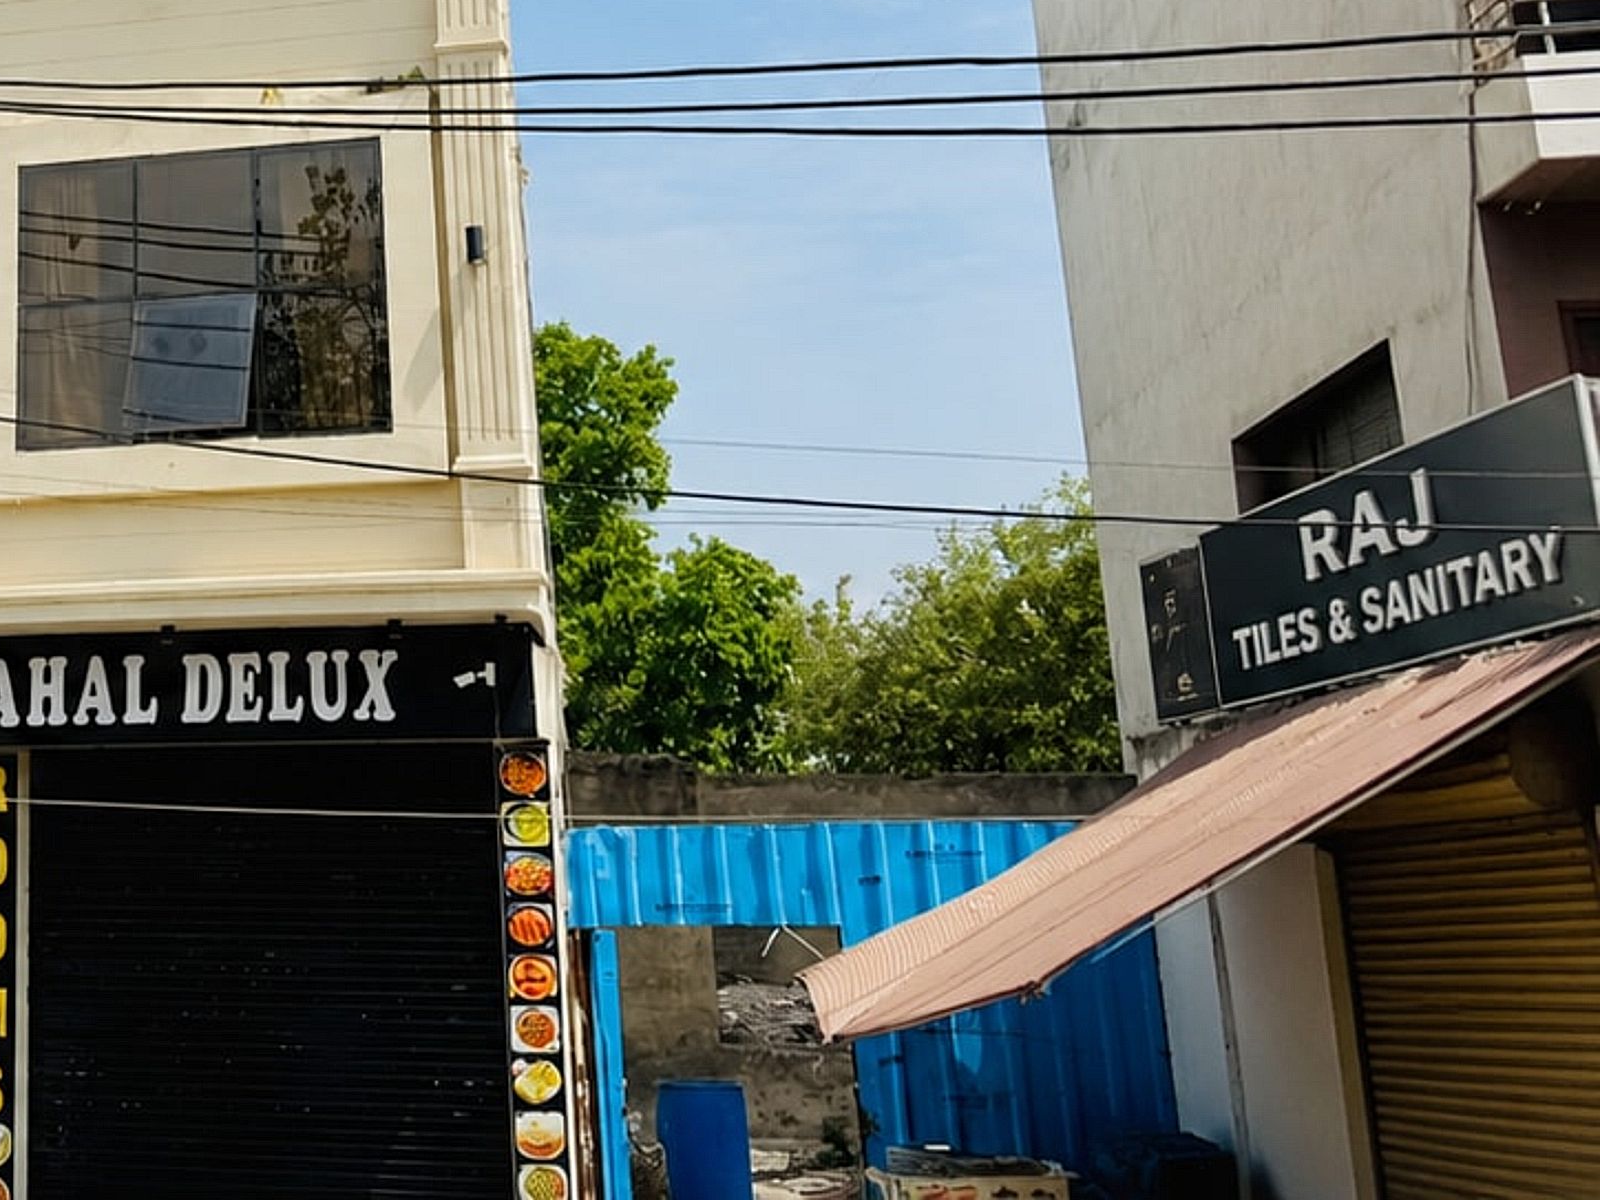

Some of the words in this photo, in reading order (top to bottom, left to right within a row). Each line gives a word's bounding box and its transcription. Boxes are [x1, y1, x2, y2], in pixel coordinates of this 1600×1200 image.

[1299, 468, 1436, 581] RAJ
[1233, 607, 1320, 670] TILES
[1328, 598, 1357, 644] &
[1360, 526, 1566, 634] SANITARY
[182, 650, 399, 724] DELUX
